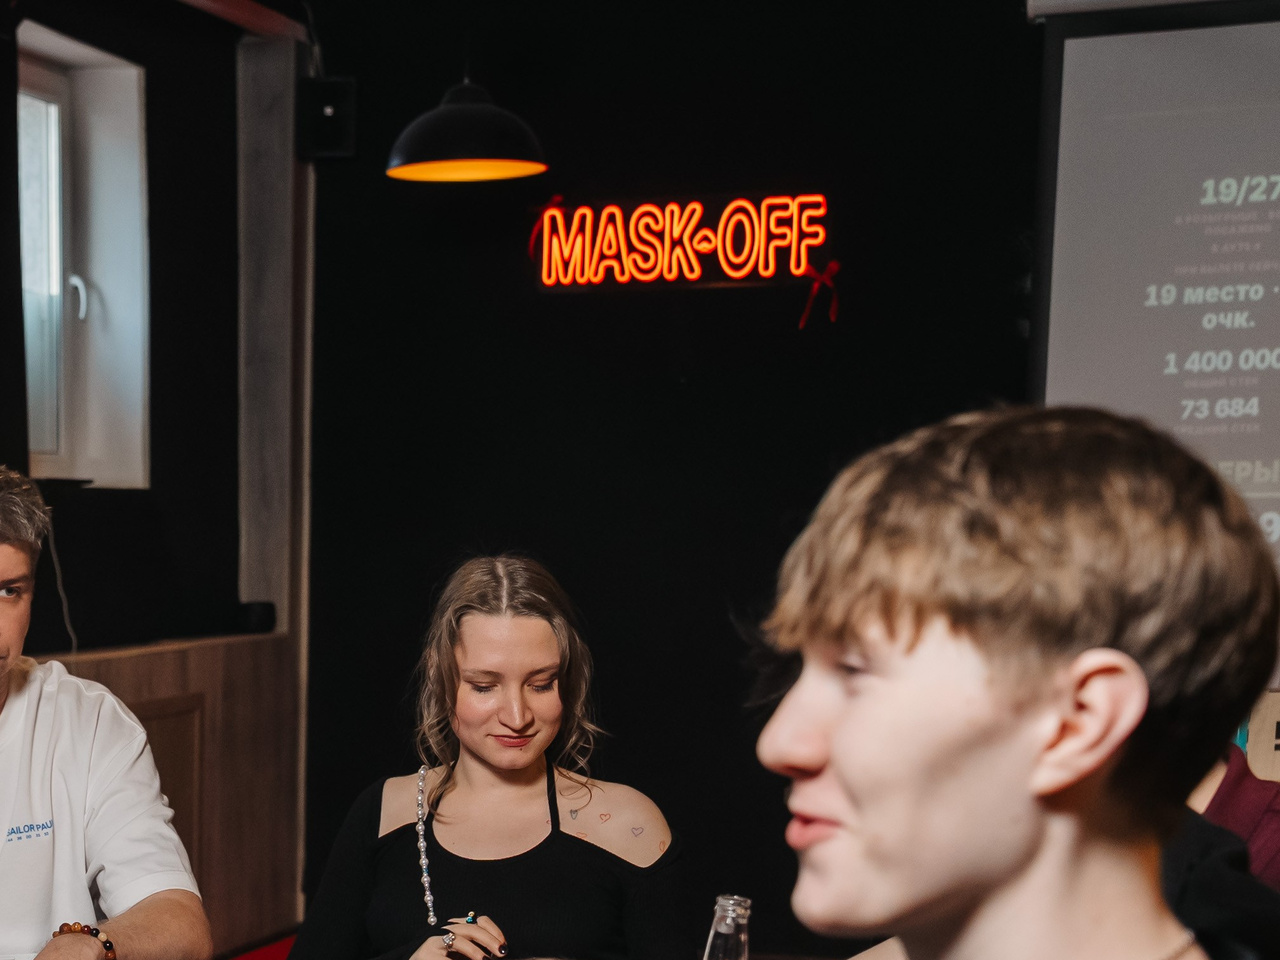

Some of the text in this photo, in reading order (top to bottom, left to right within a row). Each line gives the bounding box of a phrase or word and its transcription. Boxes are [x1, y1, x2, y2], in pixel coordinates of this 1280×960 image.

[1144, 283, 1265, 307] 19 место
[1202, 311, 1256, 330] очк.
